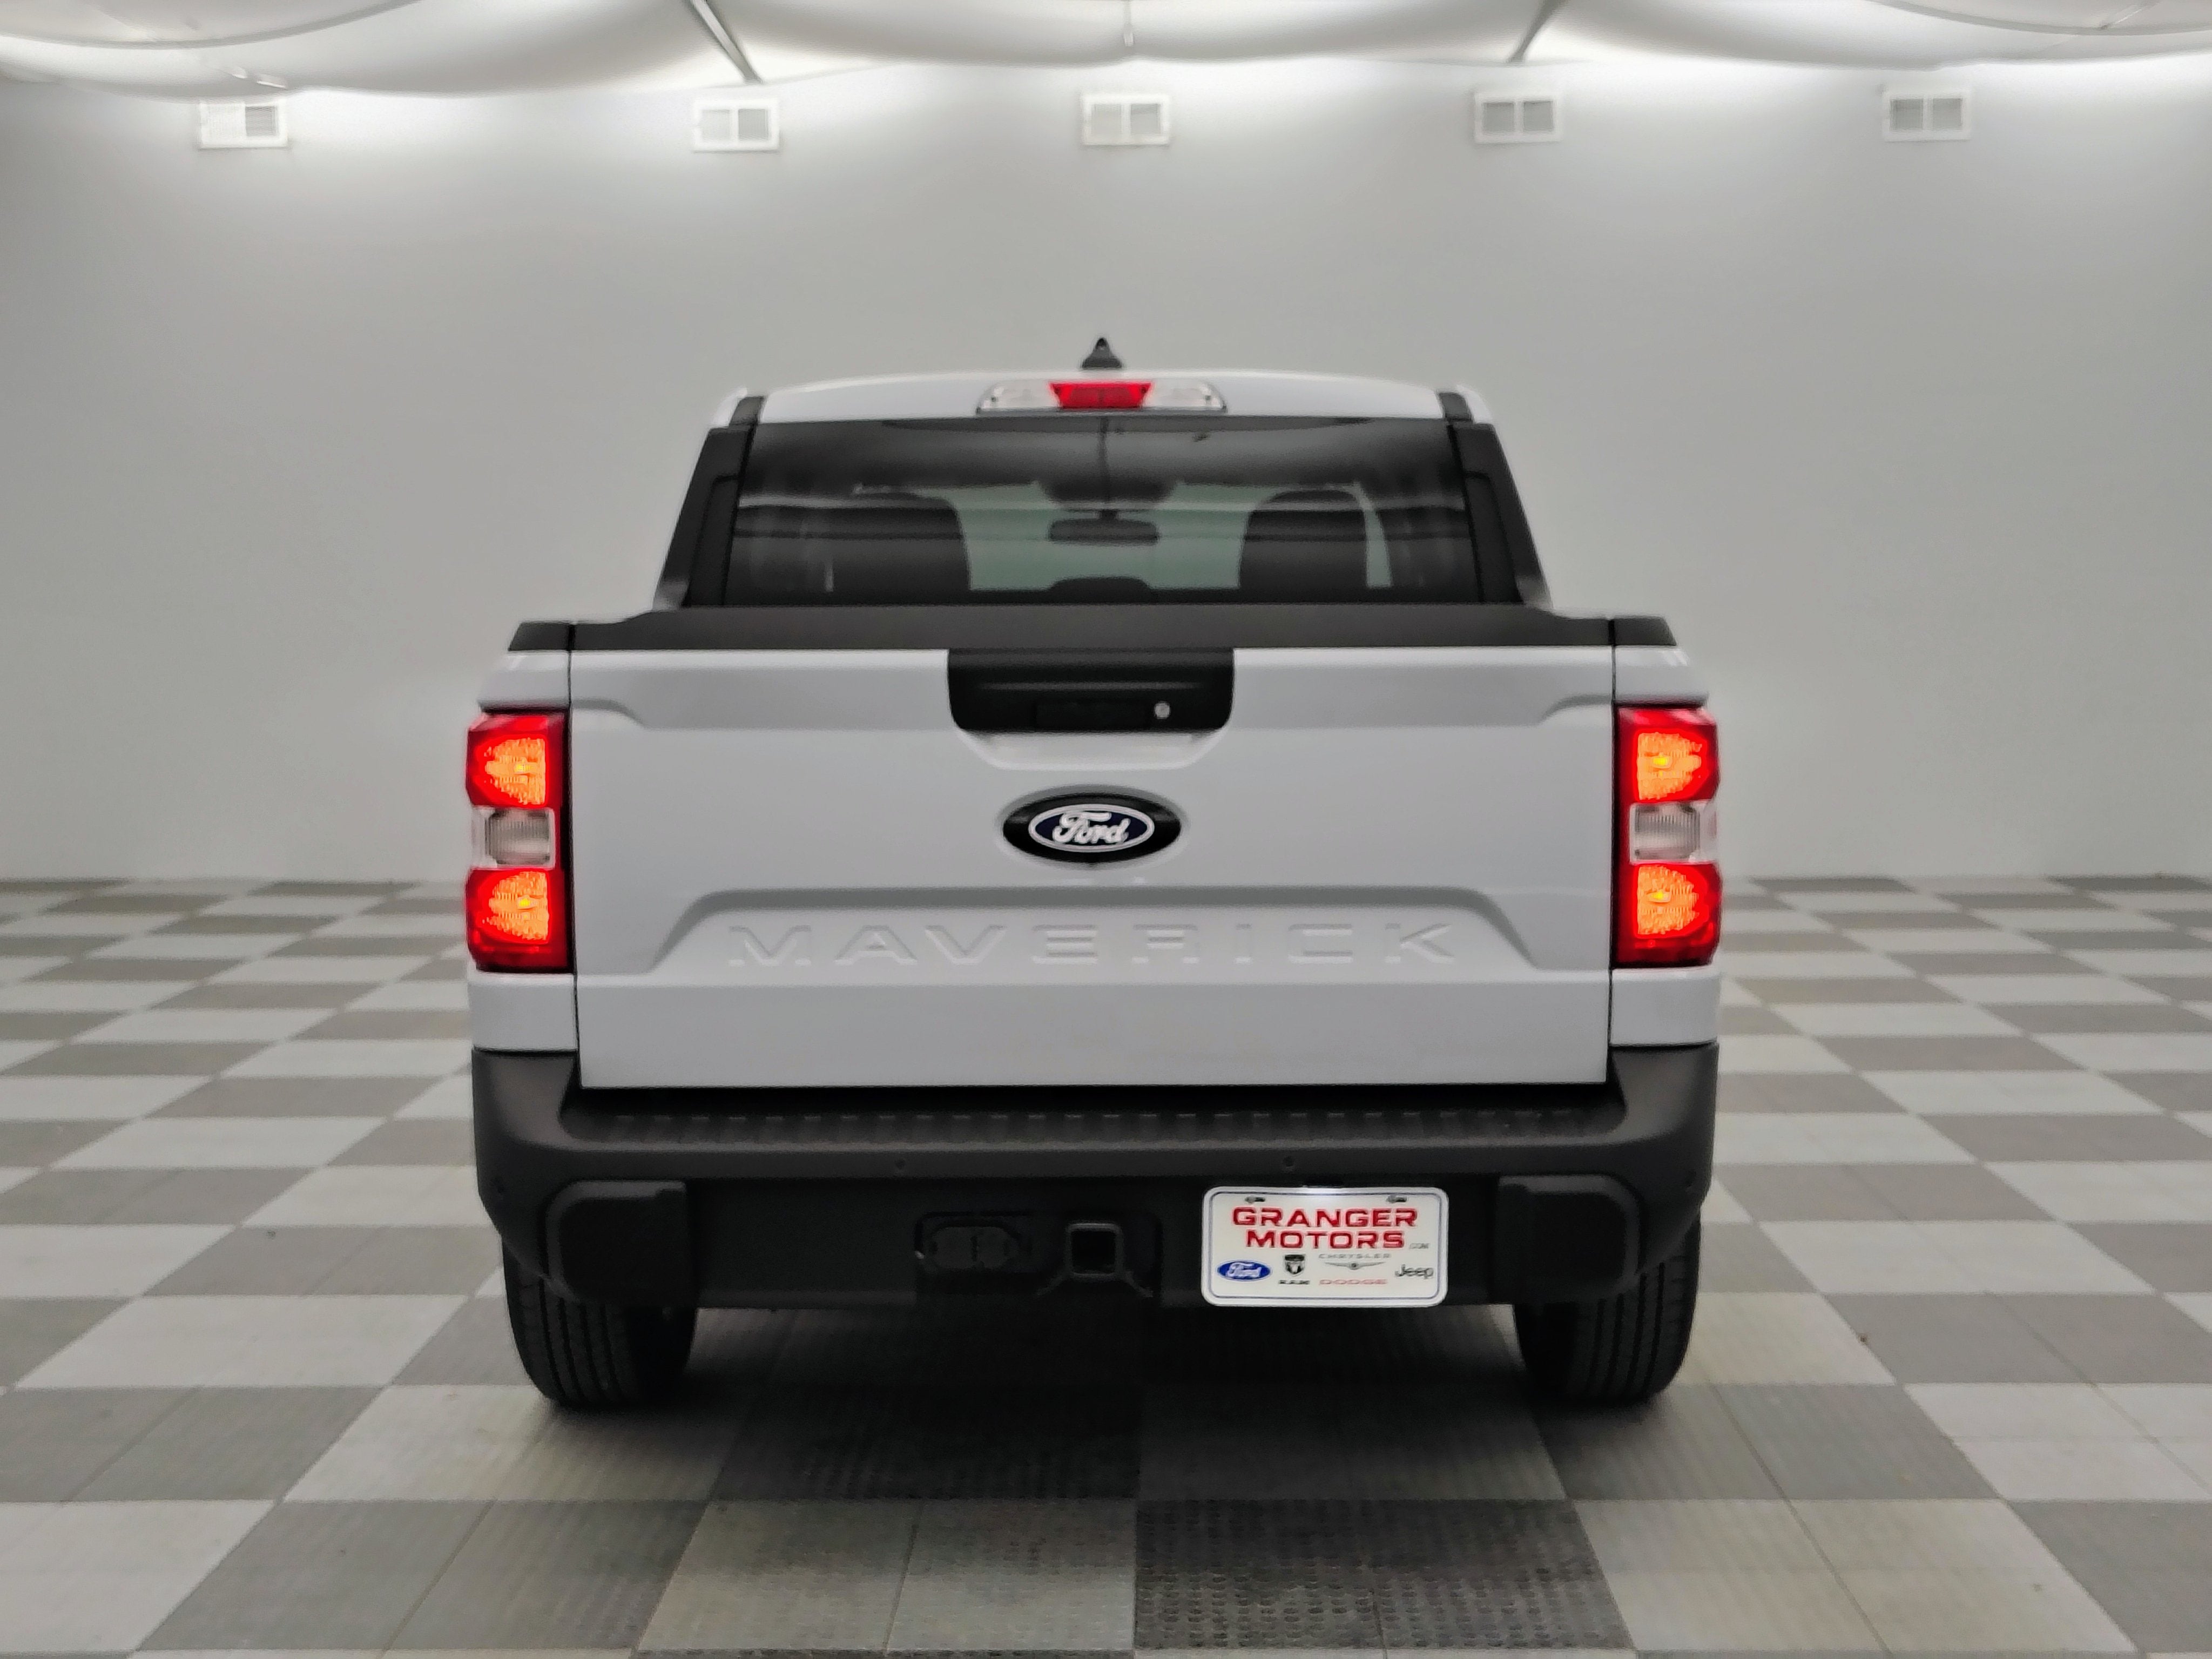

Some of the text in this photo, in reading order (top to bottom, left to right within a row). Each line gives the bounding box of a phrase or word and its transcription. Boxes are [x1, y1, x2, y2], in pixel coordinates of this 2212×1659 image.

[1052, 811, 1131, 844] Ford
[727, 923, 1455, 967] MAVERICK
[1231, 1206, 1419, 1228] GRANGER
[1245, 1229, 1405, 1249] MOTORS
[1394, 1264, 1434, 1279] Jeep
